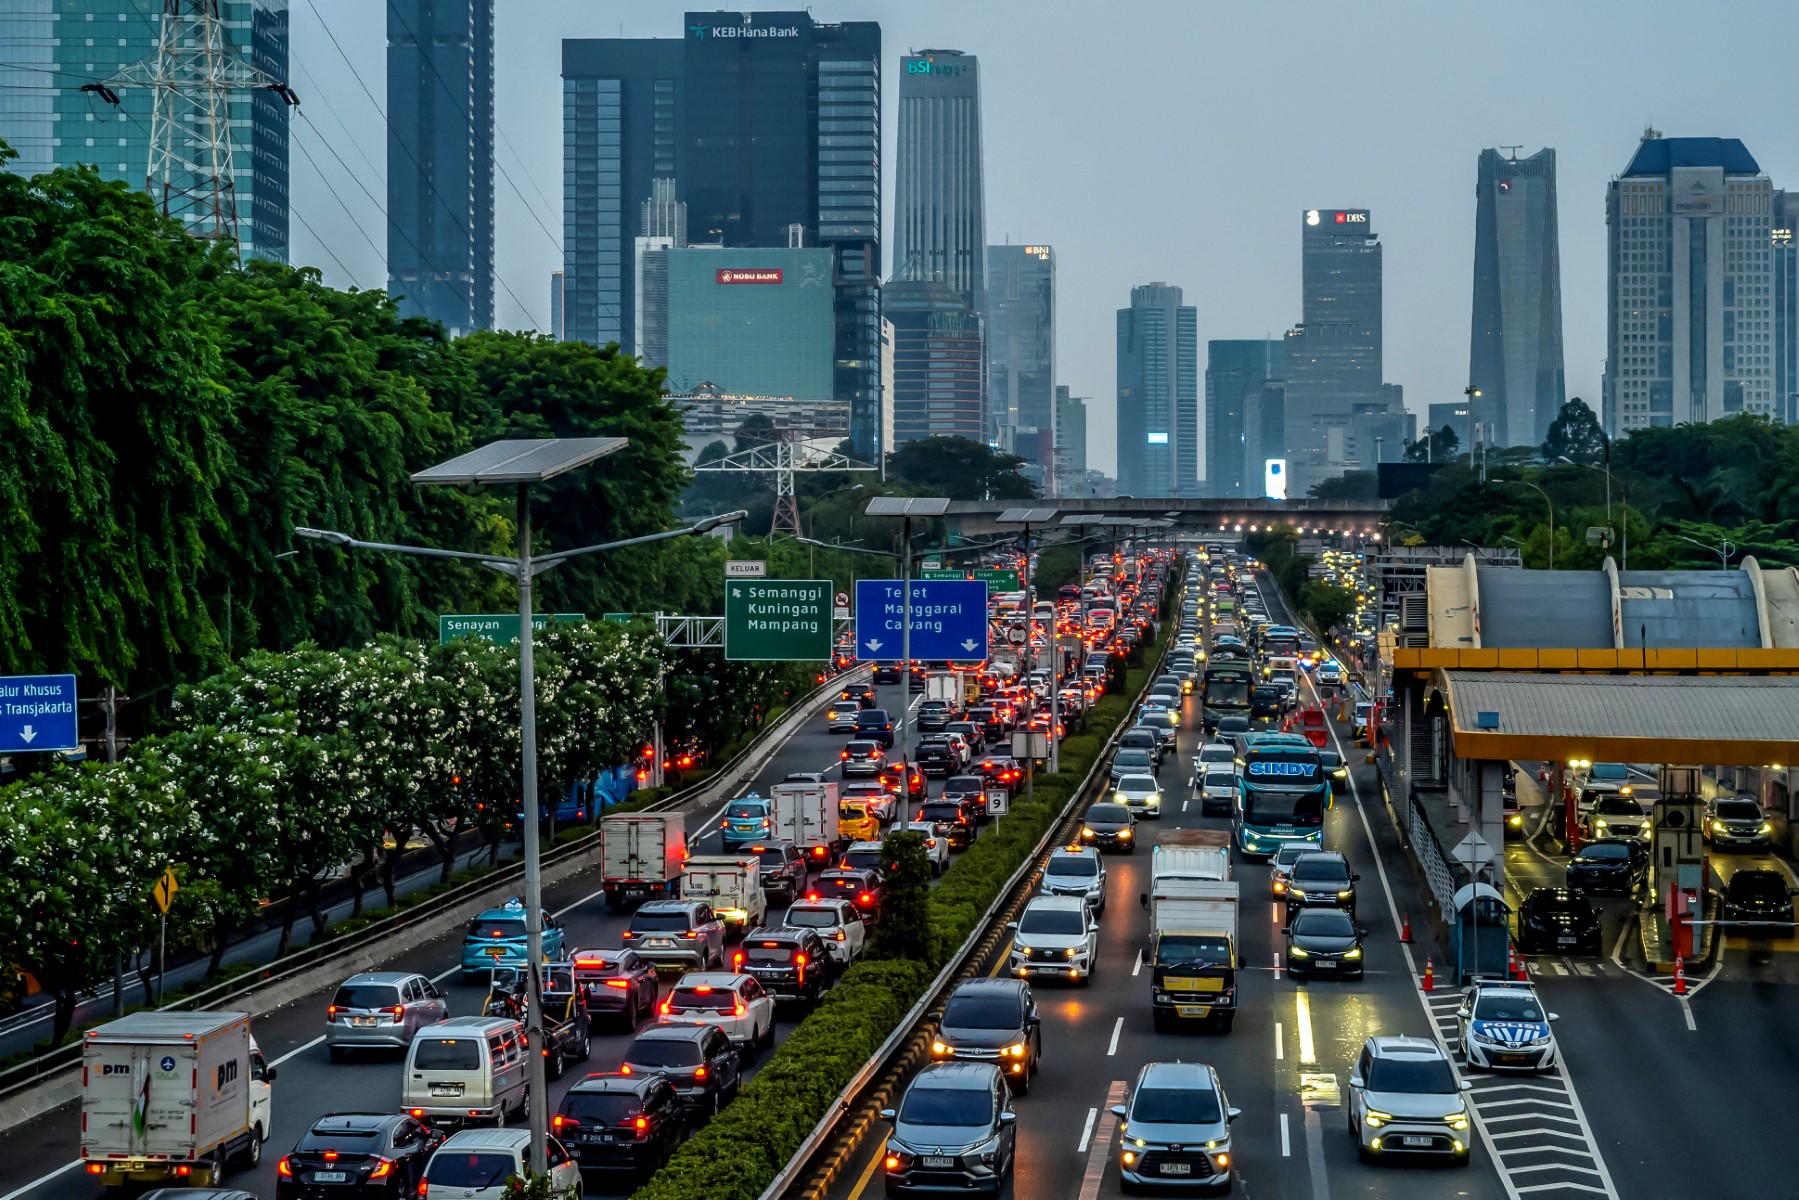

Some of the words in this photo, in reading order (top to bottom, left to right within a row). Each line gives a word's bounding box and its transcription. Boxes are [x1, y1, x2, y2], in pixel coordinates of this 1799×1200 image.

[712, 27, 736, 38] KEB
[737, 27, 768, 38] Hana
[769, 27, 799, 37] Bank
[908, 60, 930, 73] BSI
[1346, 213, 1366, 222] DBS
[1033, 246, 1049, 254] BNI
[730, 565, 760, 573] KELUAR
[748, 587, 822, 601] Semanggi
[885, 587, 928, 598] Teet
[748, 603, 819, 617] Kuningan
[447, 620, 500, 632] Senayan
[748, 619, 819, 633] Mampang
[23, 684, 62, 696] Khusus
[6, 701, 73, 717] Transjakarta
[1249, 762, 1317, 777] SINDY
[993, 799, 1001, 808] 9
[1482, 1022, 1541, 1031] POLISI
[155, 1071, 180, 1080] TALA
